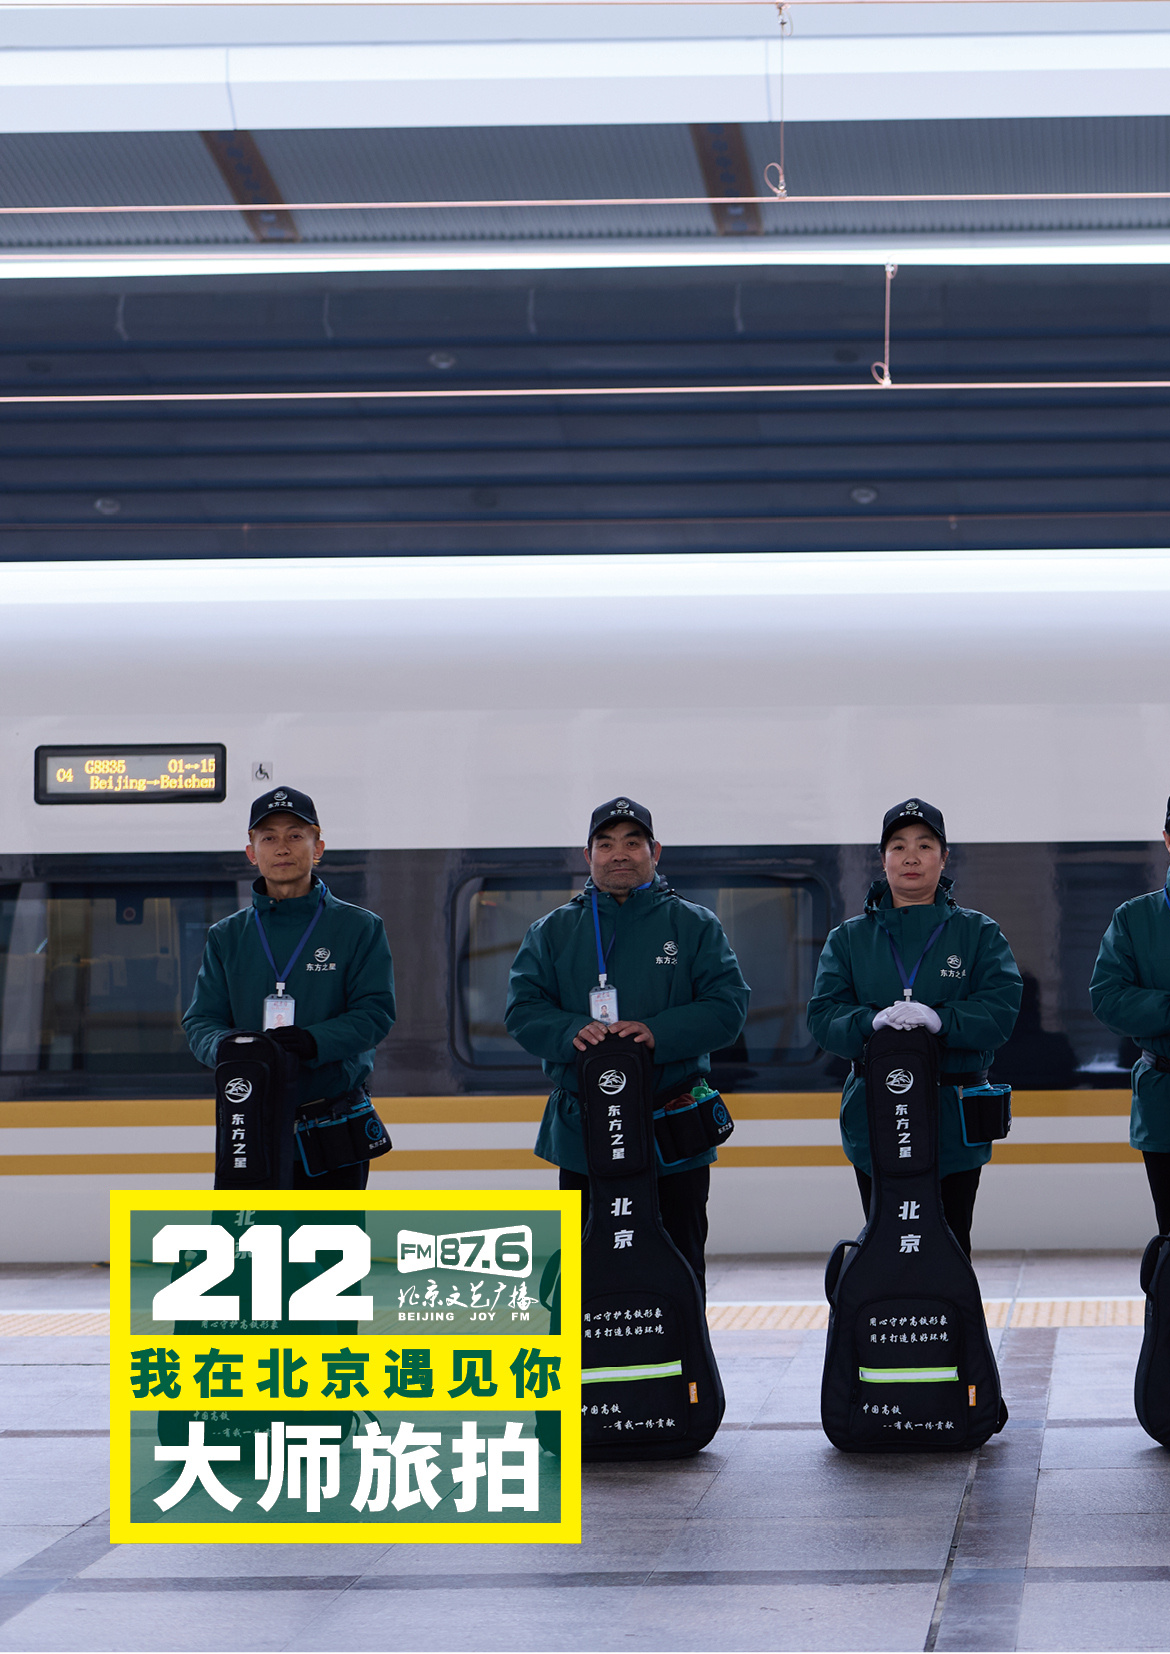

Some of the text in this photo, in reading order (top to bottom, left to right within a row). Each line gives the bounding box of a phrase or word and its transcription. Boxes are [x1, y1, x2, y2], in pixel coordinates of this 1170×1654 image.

[85, 760, 126, 774] G8835
[56, 768, 74, 783] 04
[90, 773, 216, 791] Beijing Beichen
[268, 800, 293, 808] 东方之星
[610, 807, 634, 816] 东方之星
[307, 963, 335, 971] 东方之星
[608, 1105, 624, 1159] 东方之星
[895, 1104, 911, 1158] 东方之星
[232, 1114, 246, 1168] 东方之星
[611, 1198, 634, 1249] 北京
[899, 1201, 921, 1253] 北京
[584, 1308, 662, 1322] 用心守护高铁形象
[870, 1315, 947, 1327] 用心守护高铁形象
[585, 1325, 664, 1338] 用手打造良好环境
[871, 1332, 948, 1343] 用手打造良好环境
[582, 1404, 621, 1415] 中国高铁
[863, 1403, 901, 1415] 中国高铁
